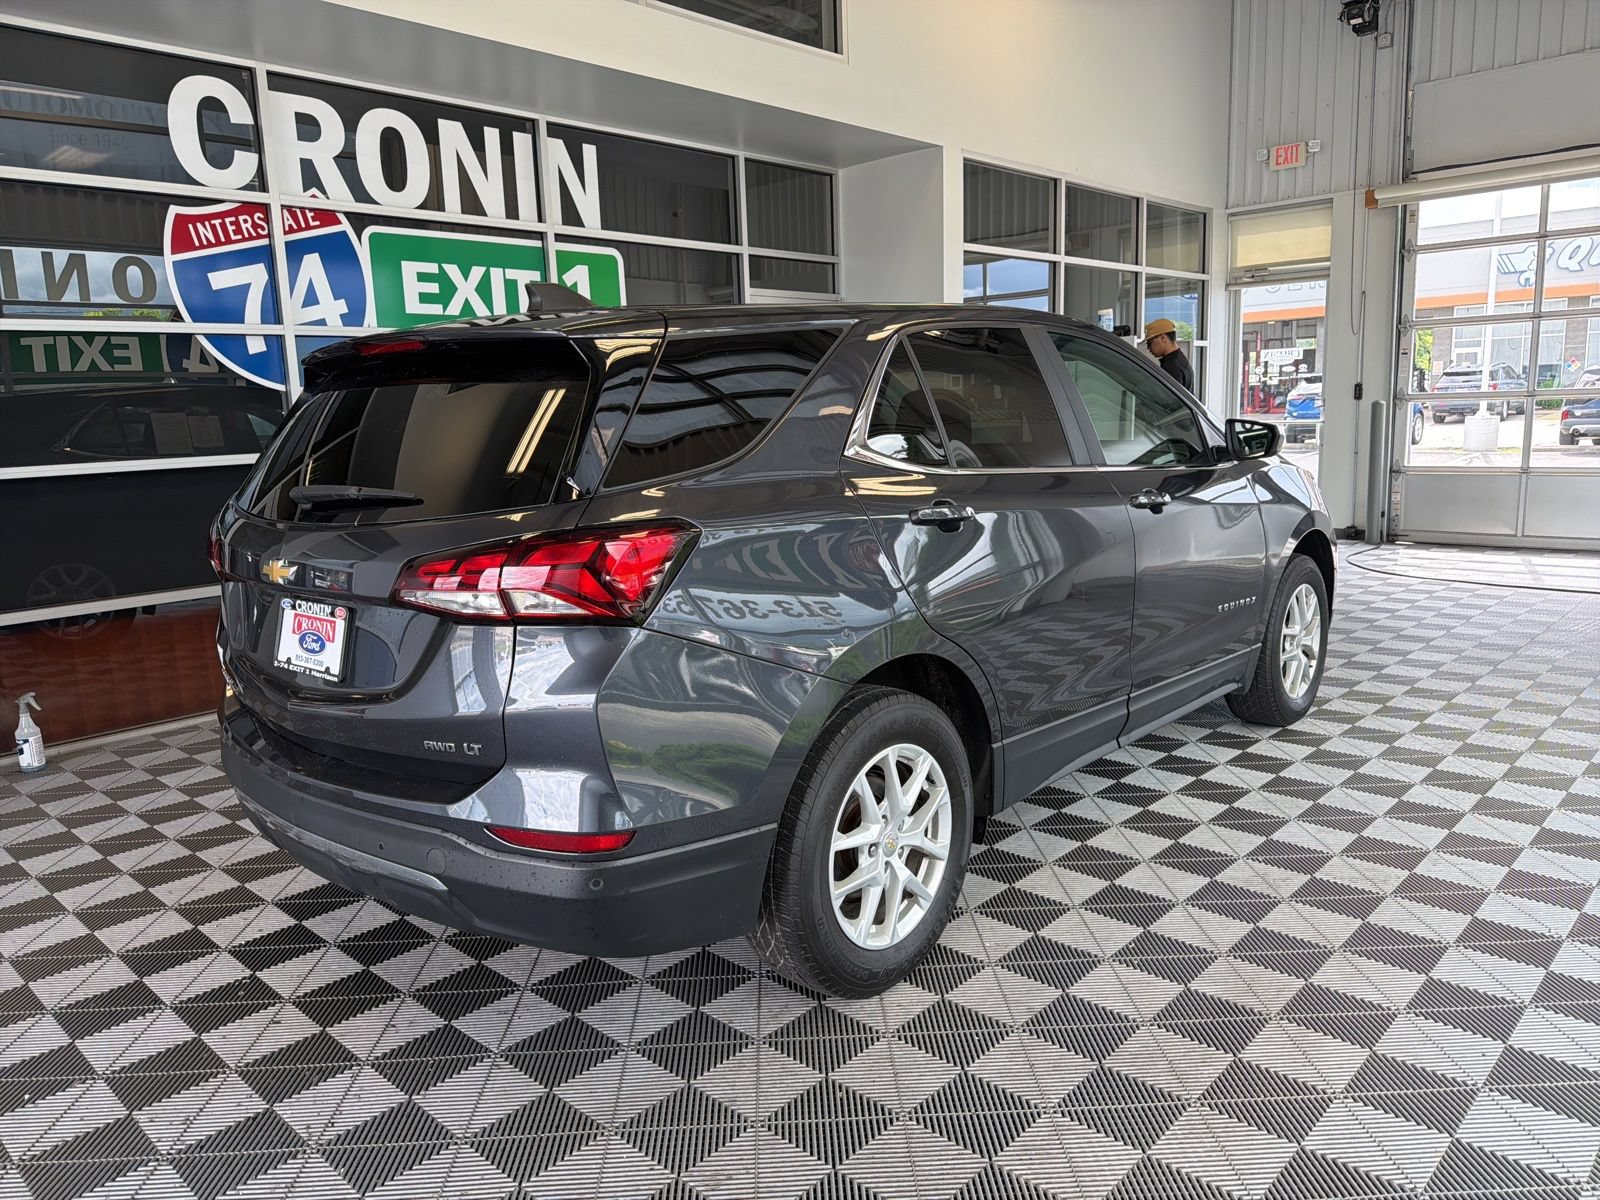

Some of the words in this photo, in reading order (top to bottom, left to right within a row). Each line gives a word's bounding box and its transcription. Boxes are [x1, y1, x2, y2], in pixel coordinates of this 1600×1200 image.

[167, 75, 601, 229] CRONIN
[1275, 143, 1301, 167] EXIT
[188, 204, 321, 247] INTERSATE
[400, 260, 541, 317] EXIT
[561, 264, 592, 301] 1
[207, 252, 347, 355] 74
[295, 600, 331, 617] CRONIN
[1217, 596, 1256, 613] EQUINOX
[294, 615, 335, 642] CRONIN
[302, 633, 321, 651] Ford
[289, 664, 304, 673] EXIT
[311, 669, 338, 682] Harrison
[423, 740, 456, 753] AWD
[462, 742, 482, 756] LT
